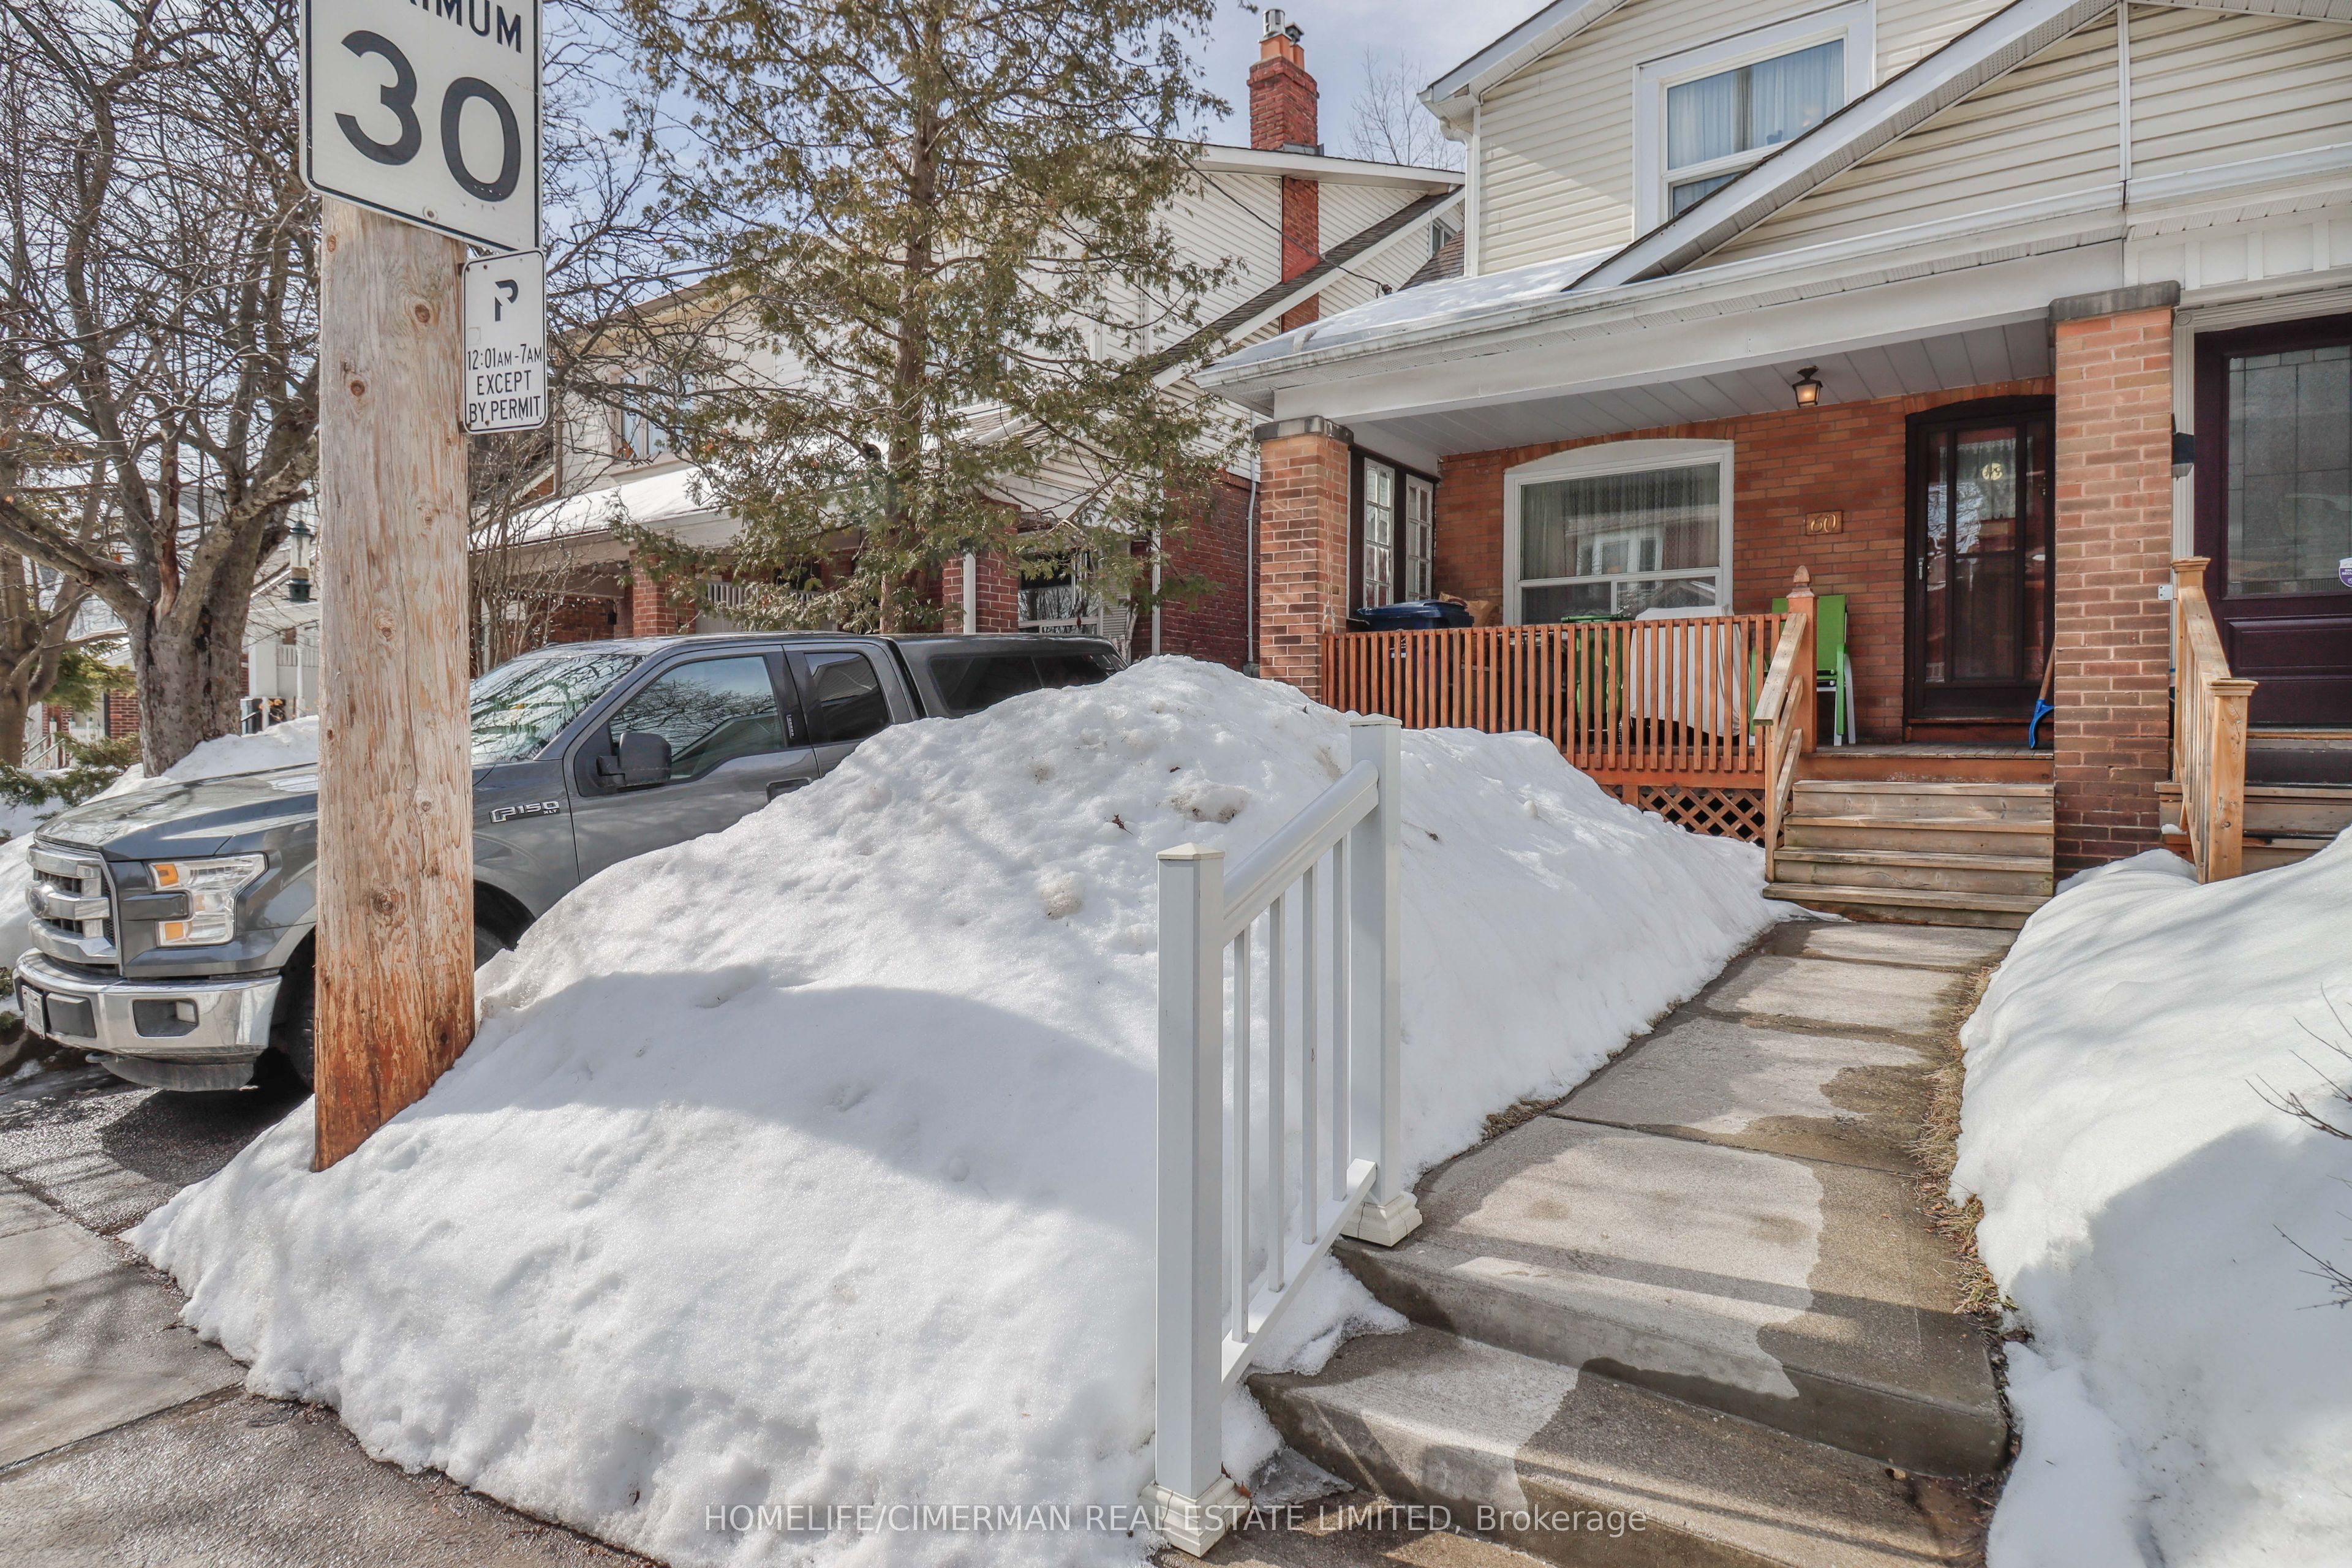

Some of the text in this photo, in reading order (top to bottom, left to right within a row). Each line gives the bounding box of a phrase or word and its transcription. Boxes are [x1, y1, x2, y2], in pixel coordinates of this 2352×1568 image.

[334, 30, 521, 202] 30
[495, 279, 518, 322] P
[477, 370, 532, 396] EXCEPT
[469, 396, 541, 423] BY PERMIT
[1811, 514, 1837, 532] 60
[491, 801, 560, 823] F150
